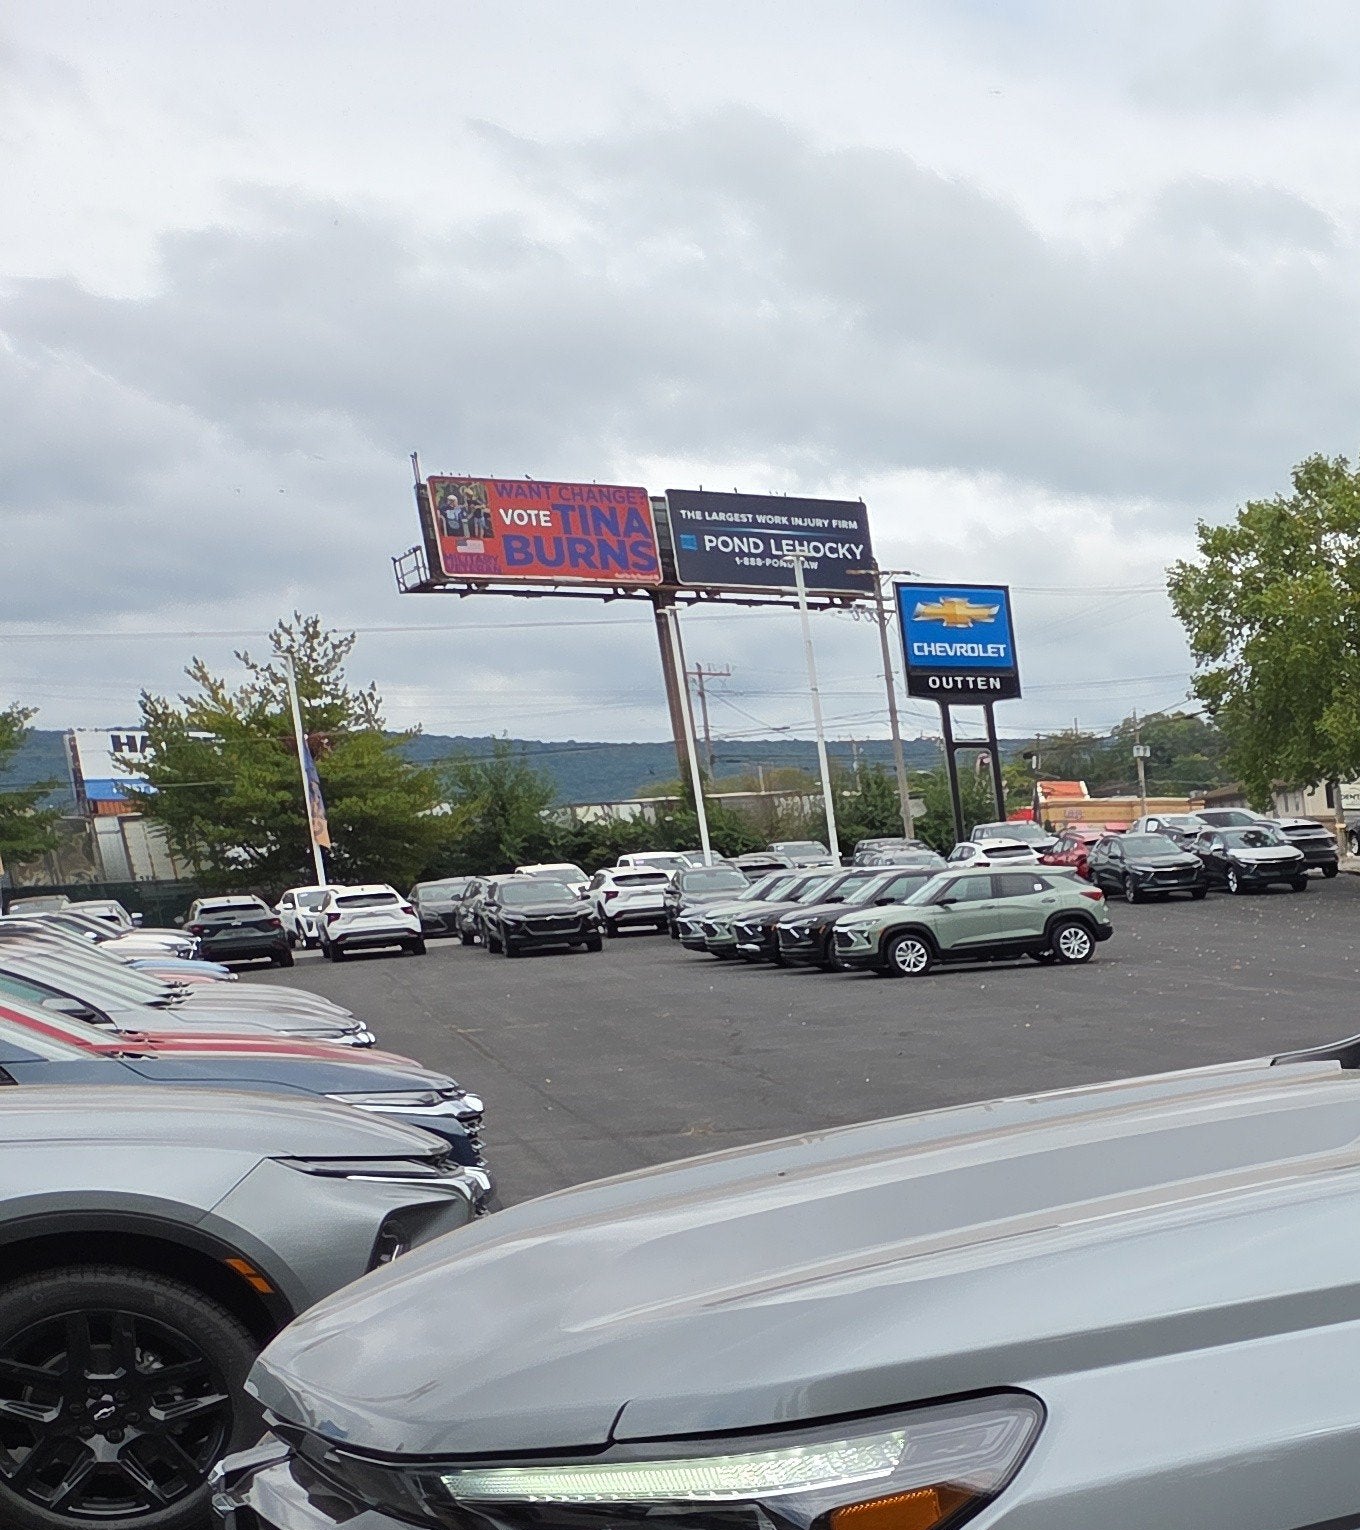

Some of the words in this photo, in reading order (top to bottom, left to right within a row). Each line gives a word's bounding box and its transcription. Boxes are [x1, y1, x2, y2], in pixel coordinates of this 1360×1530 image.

[495, 482, 551, 500] WANT
[558, 484, 648, 504] CHANGE?
[499, 508, 553, 527] VOTE
[551, 503, 651, 539] TINA
[680, 509, 702, 520] THE
[704, 511, 753, 523] LARGEST
[755, 514, 789, 526] WORK
[791, 517, 829, 529] INJURY
[832, 519, 858, 530] FIRM
[502, 533, 661, 573] BURNS
[704, 535, 764, 554] POND
[769, 538, 864, 560] LEHOCKY
[913, 642, 1006, 658] CHEVROLET
[928, 676, 1001, 690] OUTTEN
